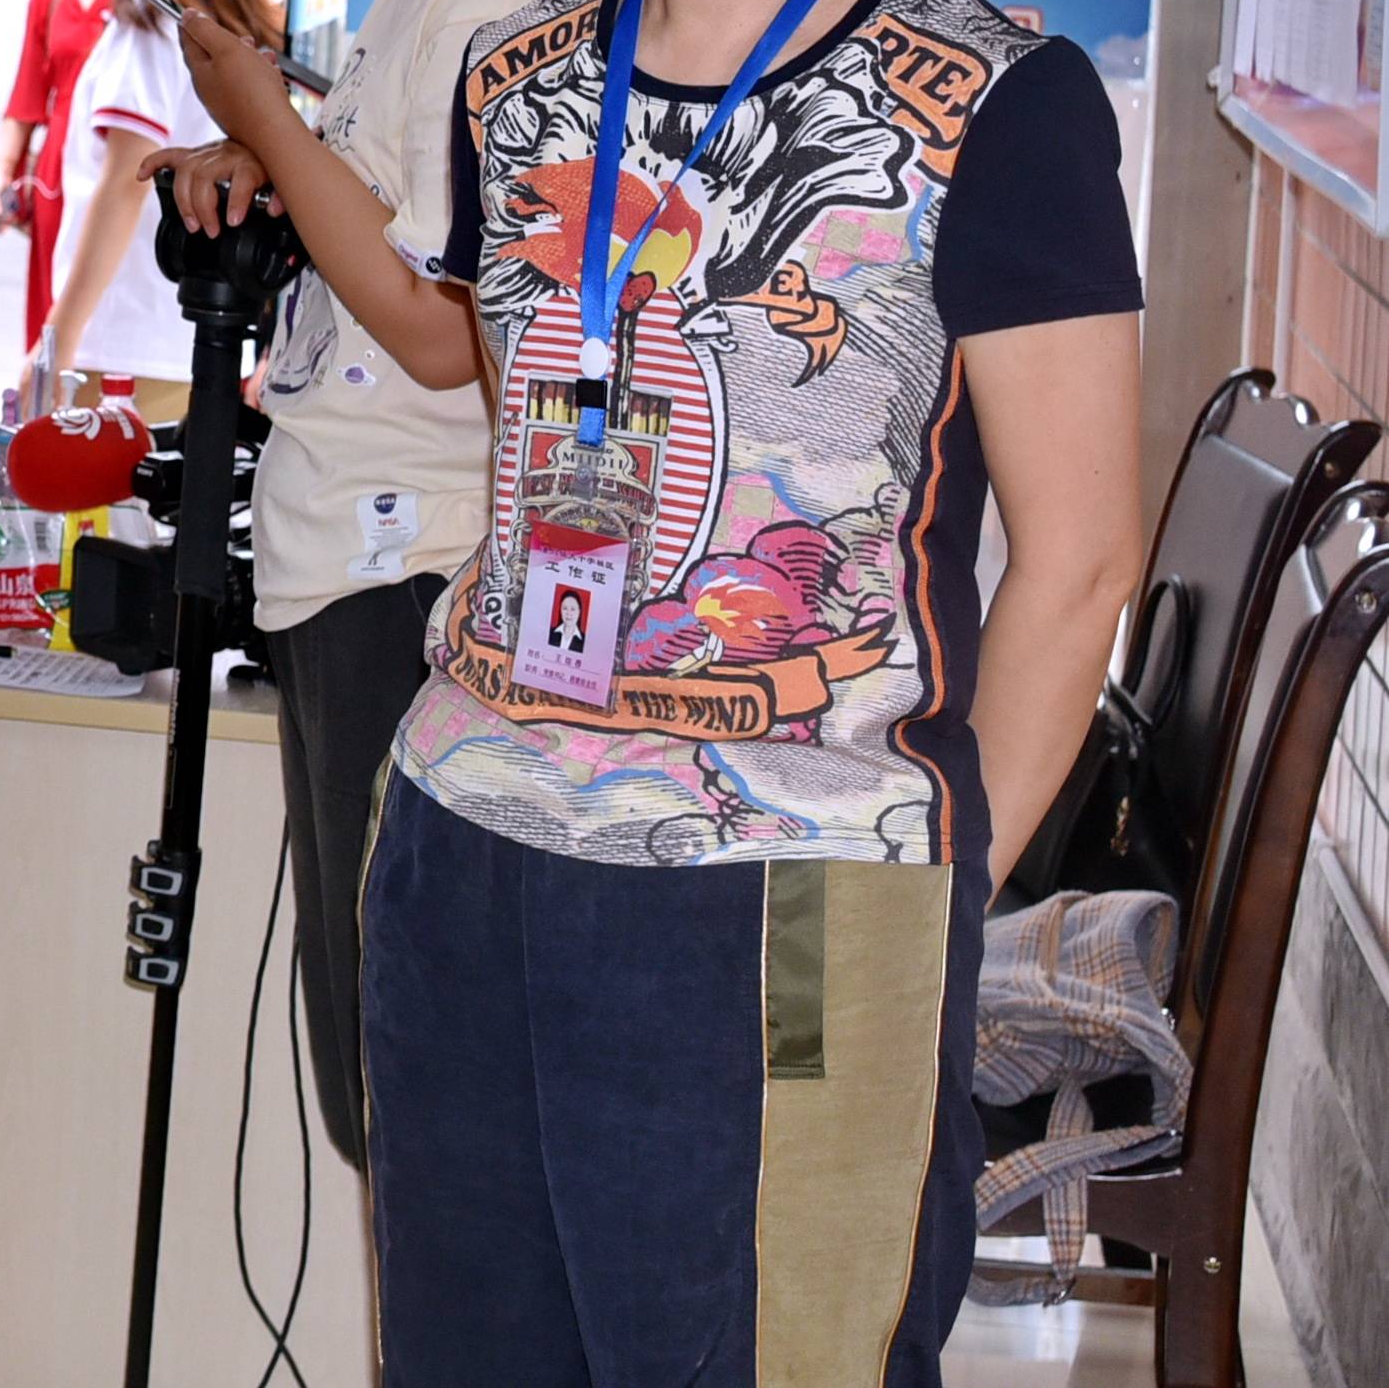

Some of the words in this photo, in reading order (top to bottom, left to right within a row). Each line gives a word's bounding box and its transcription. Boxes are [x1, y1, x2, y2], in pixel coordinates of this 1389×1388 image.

[544, 560, 607, 585] 工作证
[623, 689, 677, 721] THE
[679, 693, 761, 733] WIND
